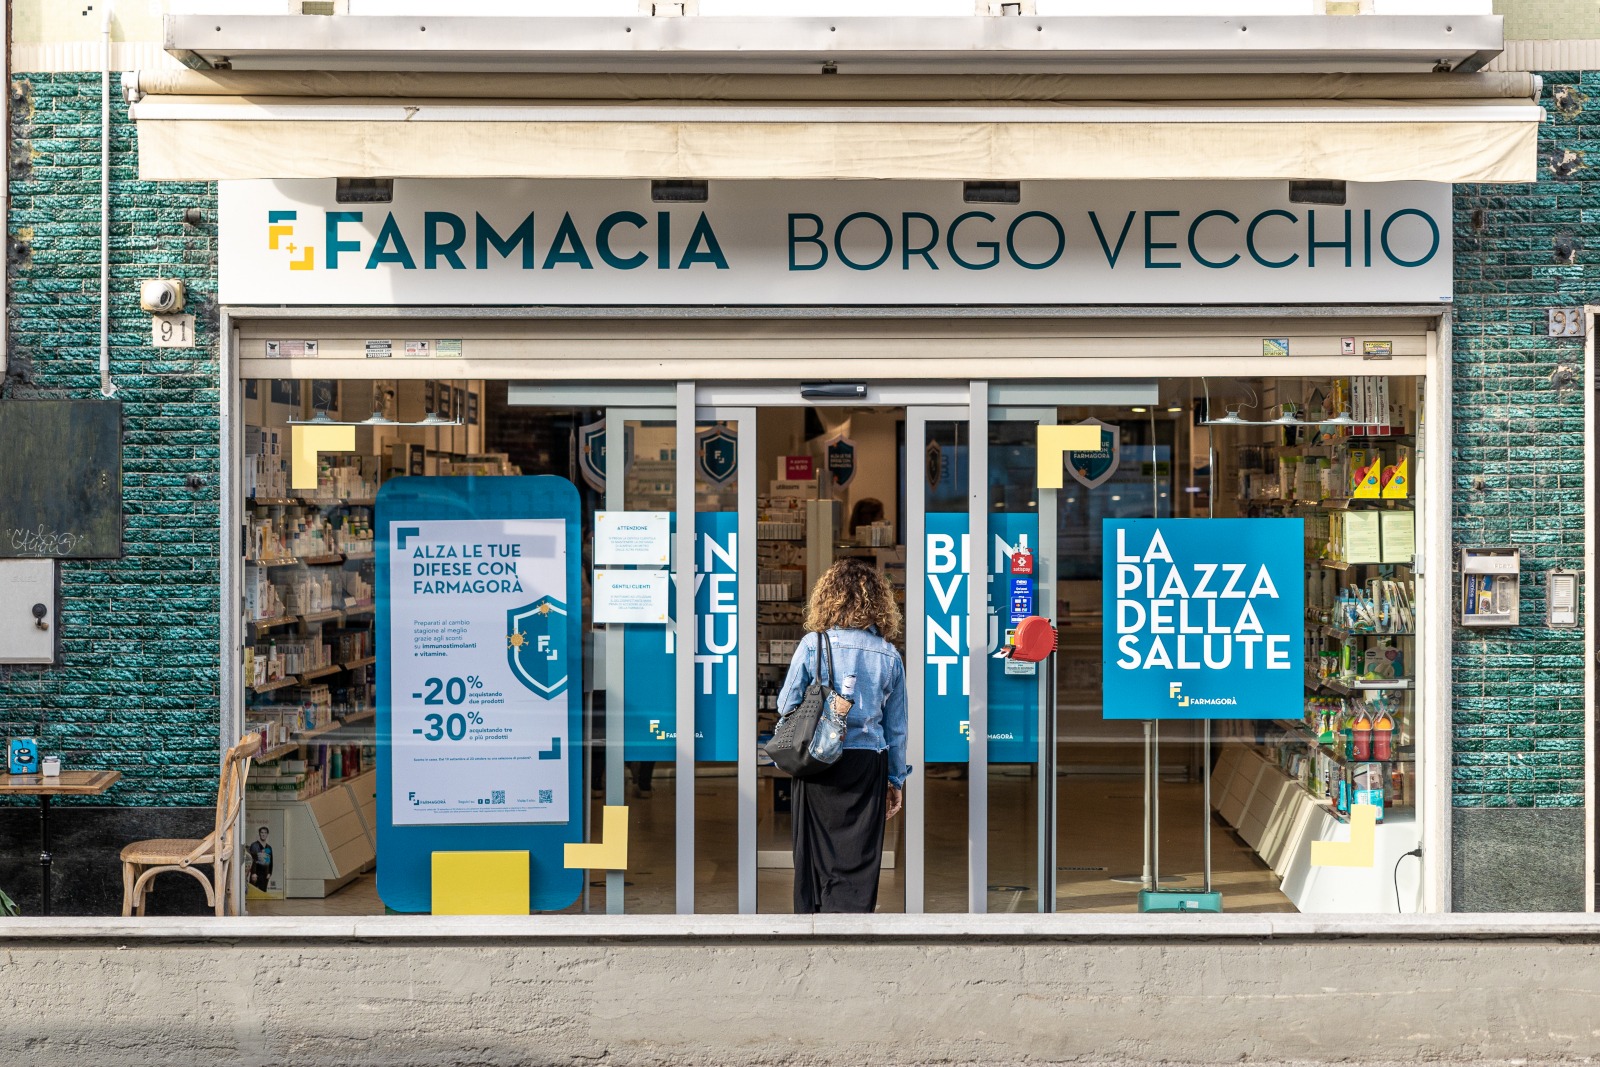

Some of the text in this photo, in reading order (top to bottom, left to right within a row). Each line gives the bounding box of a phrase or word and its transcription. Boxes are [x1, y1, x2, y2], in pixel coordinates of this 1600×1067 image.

[325, 208, 1439, 271] FARMACIA BORGO VECCHIO
[161, 320, 187, 342] 91
[1552, 308, 1580, 335] 93
[413, 543, 521, 559] ALZA LE TUE
[1116, 528, 1174, 563] LA
[413, 561, 516, 577] DIFESE CON
[413, 575, 523, 595] FARMAGORÀ
[1116, 563, 1280, 599] PIAZZA
[414, 619, 441, 627] Preparati
[1116, 599, 1265, 634] DELLA
[414, 627, 439, 635] stagione
[447, 627, 467, 635] meglio
[1116, 634, 1291, 670] SALUTE
[1190, 696, 1237, 705] FARMAGORÀ
